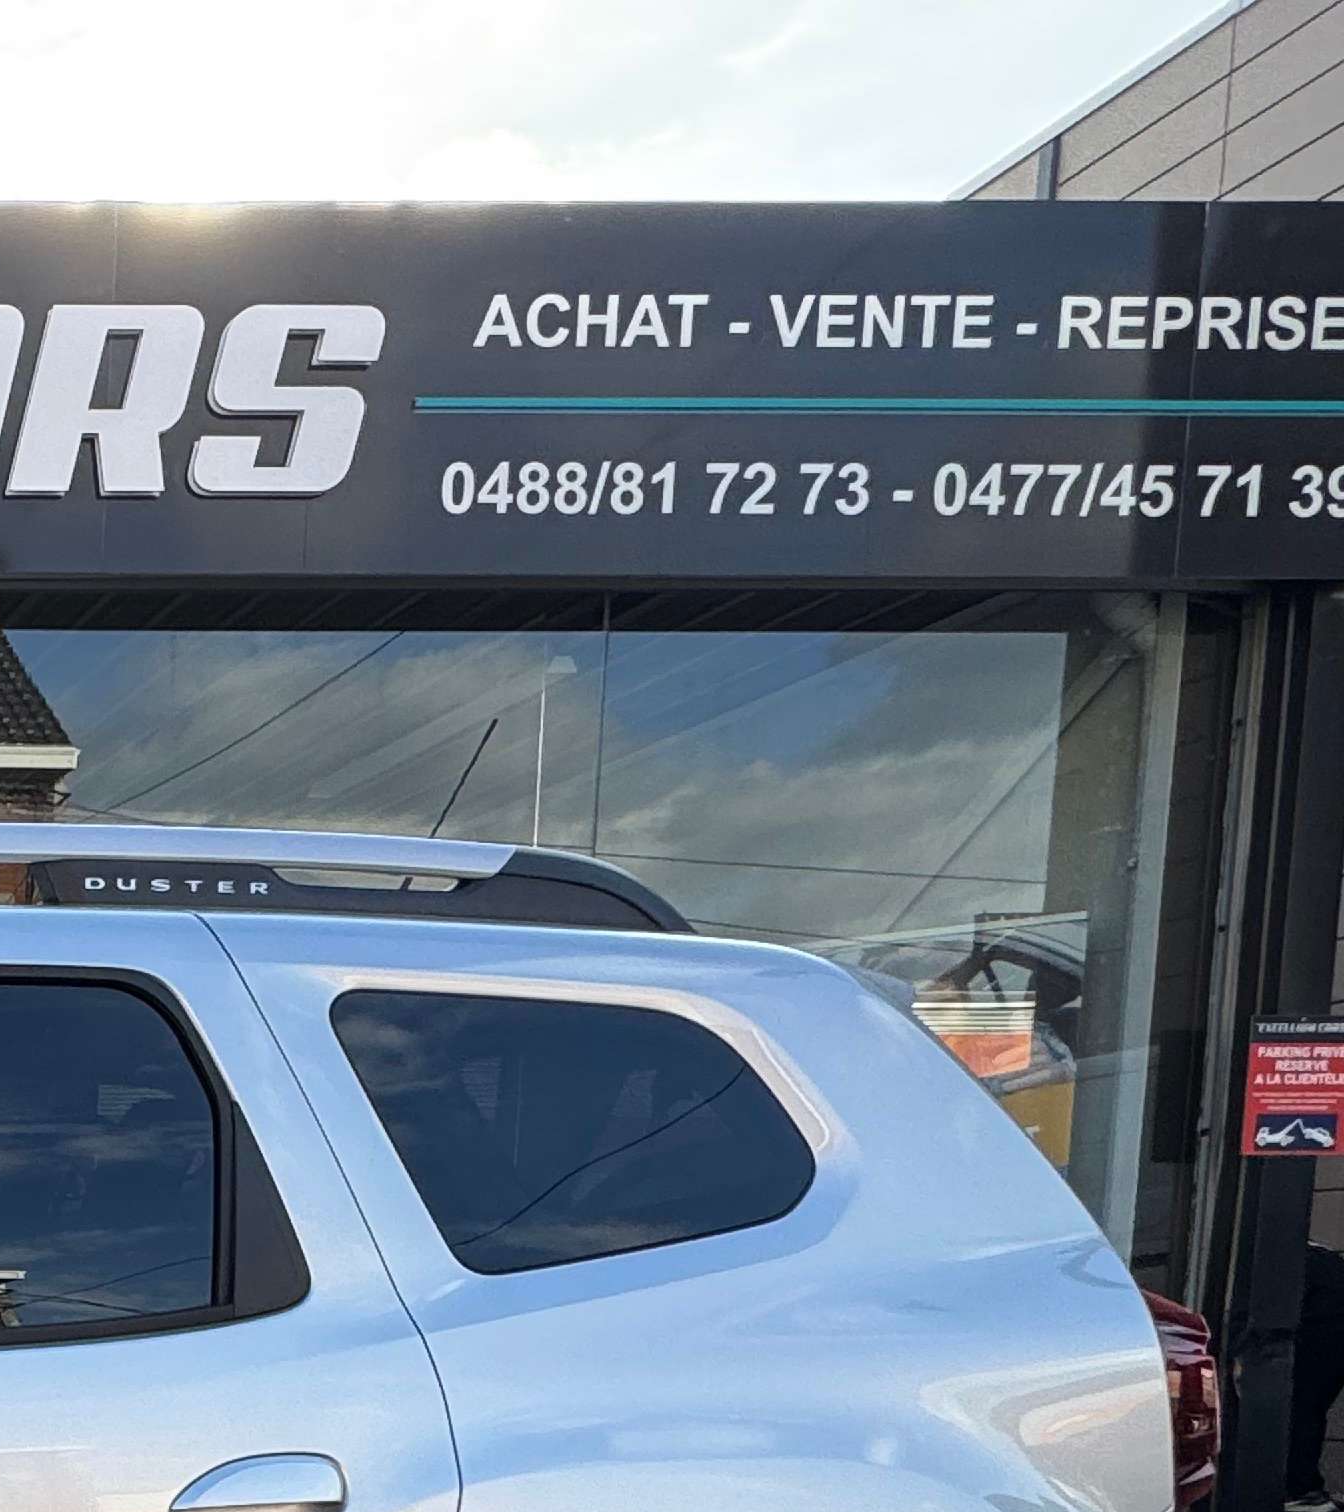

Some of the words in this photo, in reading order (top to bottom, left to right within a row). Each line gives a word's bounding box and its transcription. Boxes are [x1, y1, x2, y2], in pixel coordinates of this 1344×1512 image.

[472, 293, 710, 348] ACHAT
[769, 294, 995, 349] VENTE
[1057, 295, 1344, 351] REPRISE
[440, 460, 676, 516] 0488/81
[706, 462, 777, 516] 72
[799, 462, 870, 516] 73
[932, 462, 1175, 518] 0477/45
[1197, 464, 1262, 518] 71
[83, 877, 272, 896] DUSTER
[1266, 1074, 1281, 1085] LA
